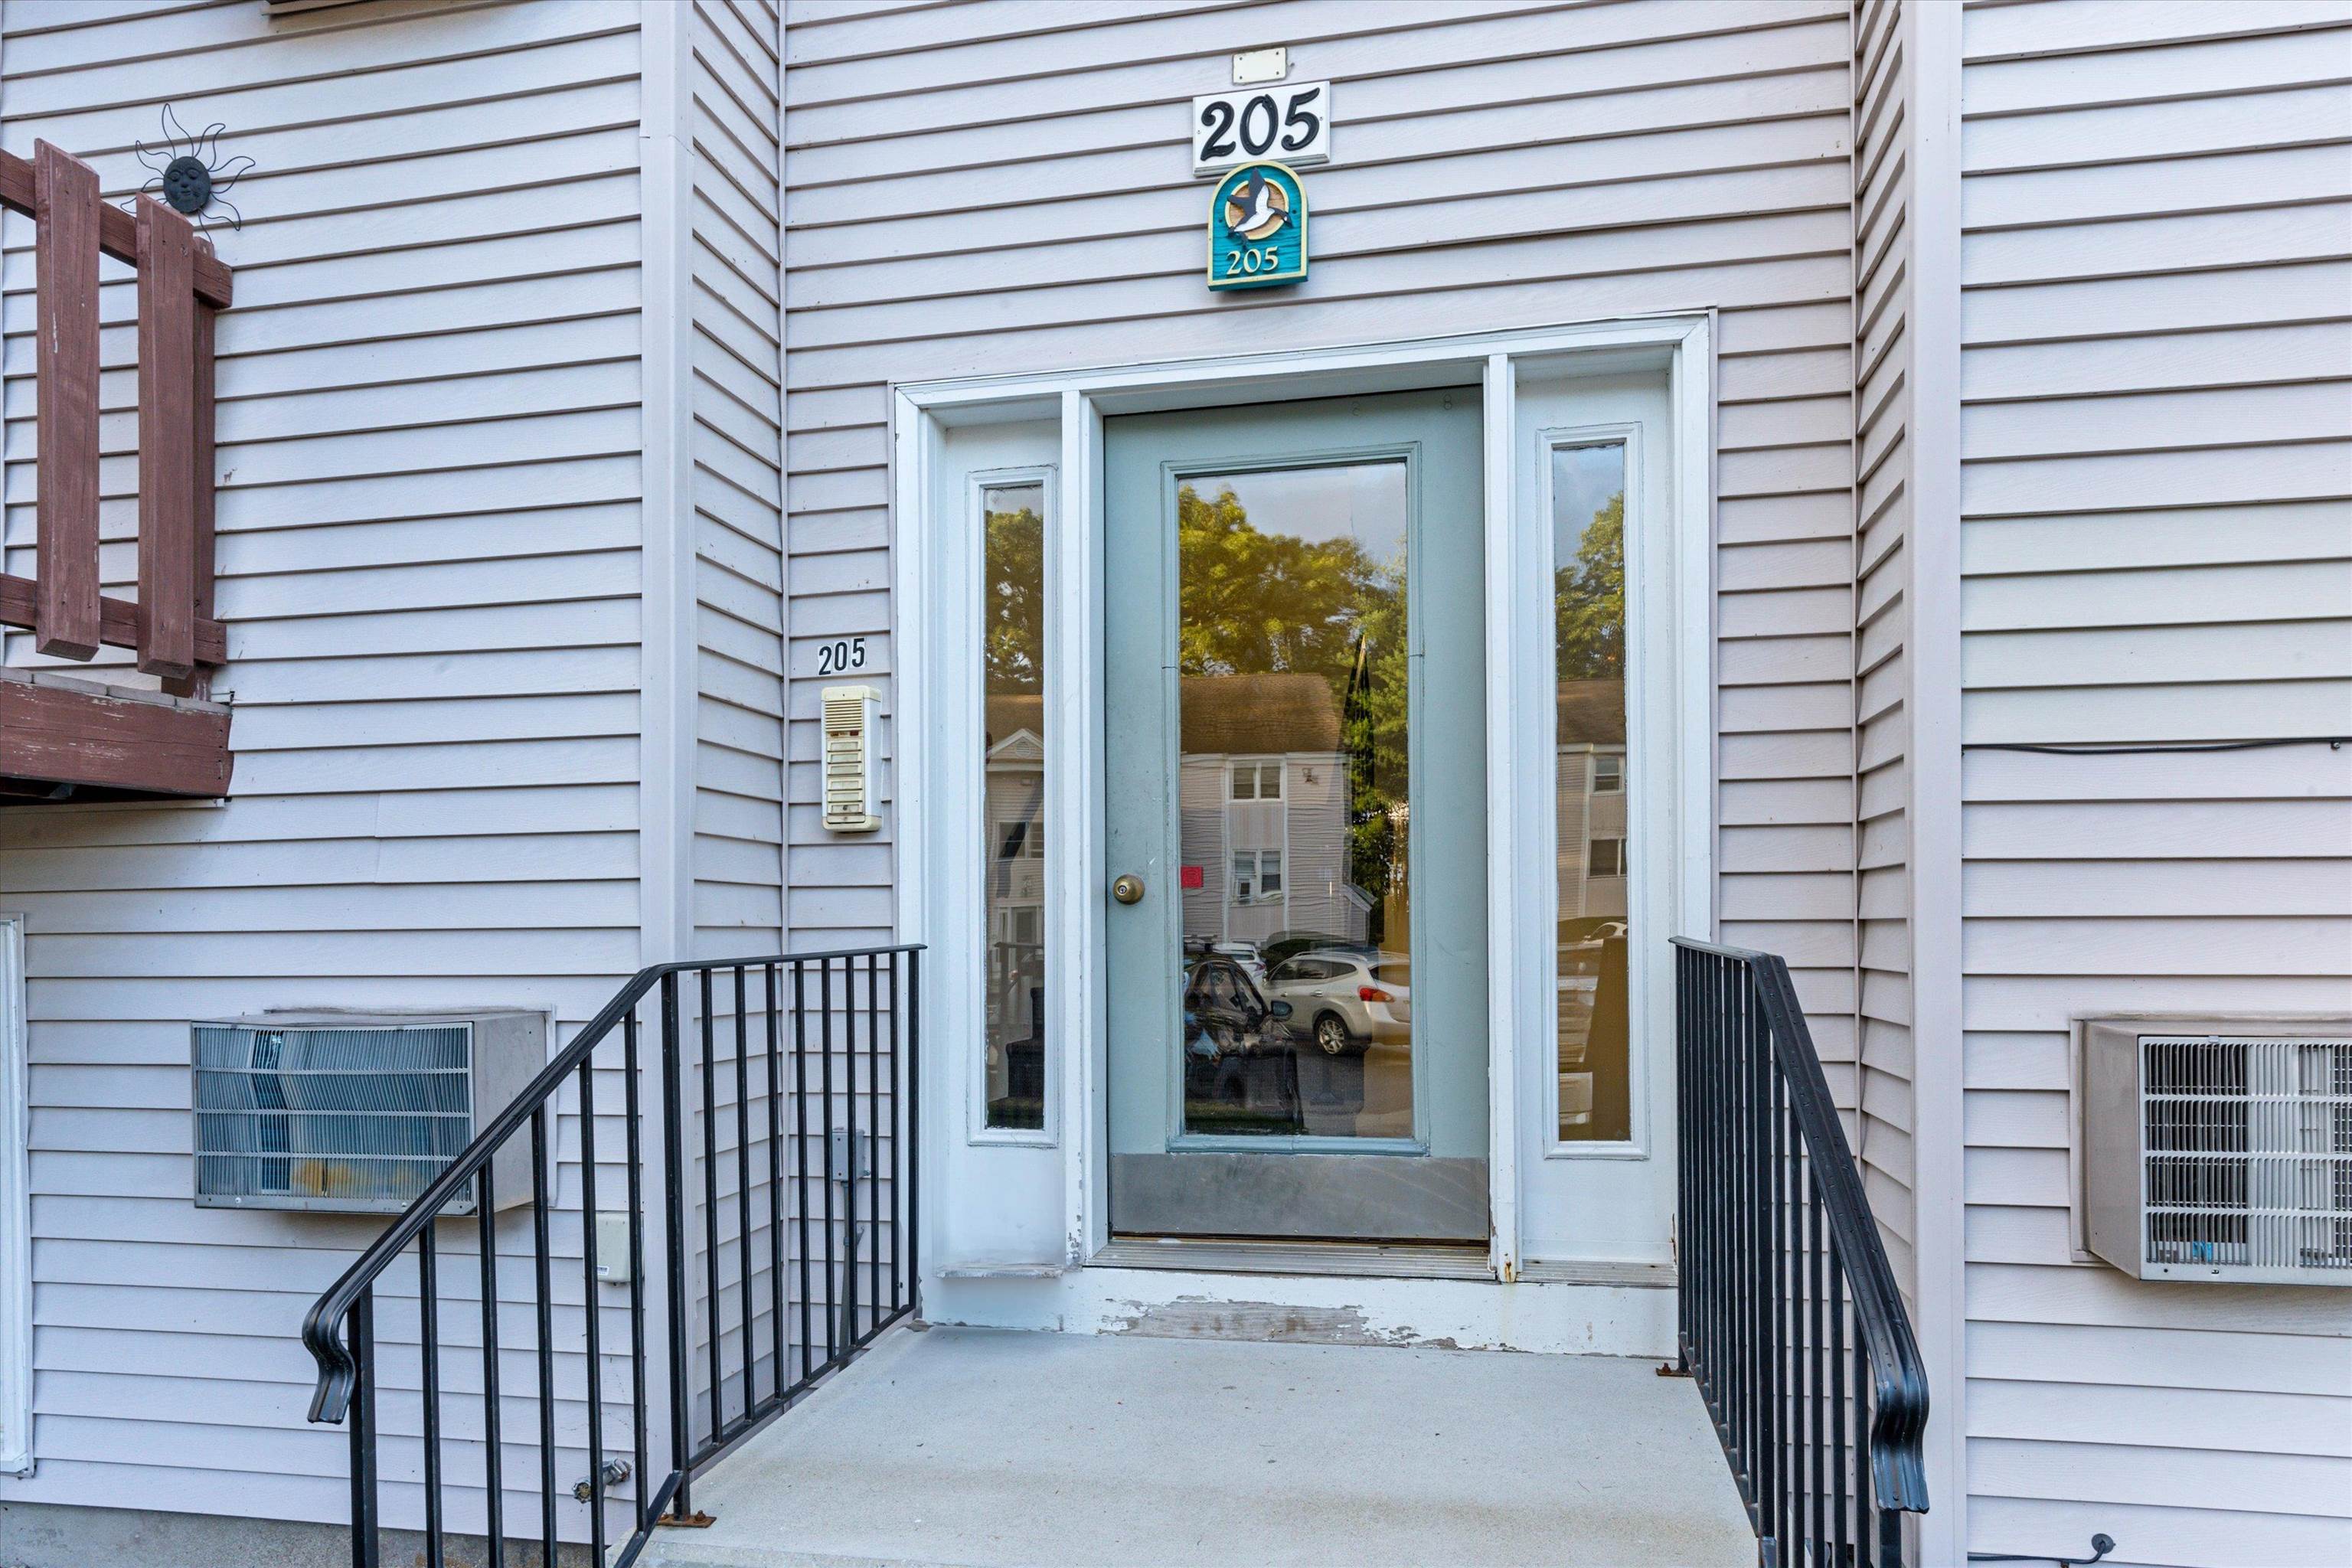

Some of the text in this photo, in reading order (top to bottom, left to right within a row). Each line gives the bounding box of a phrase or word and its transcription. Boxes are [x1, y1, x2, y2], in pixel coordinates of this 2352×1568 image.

[1200, 87, 1320, 161] 205
[1227, 246, 1279, 275] 205
[818, 638, 865, 675] 205
